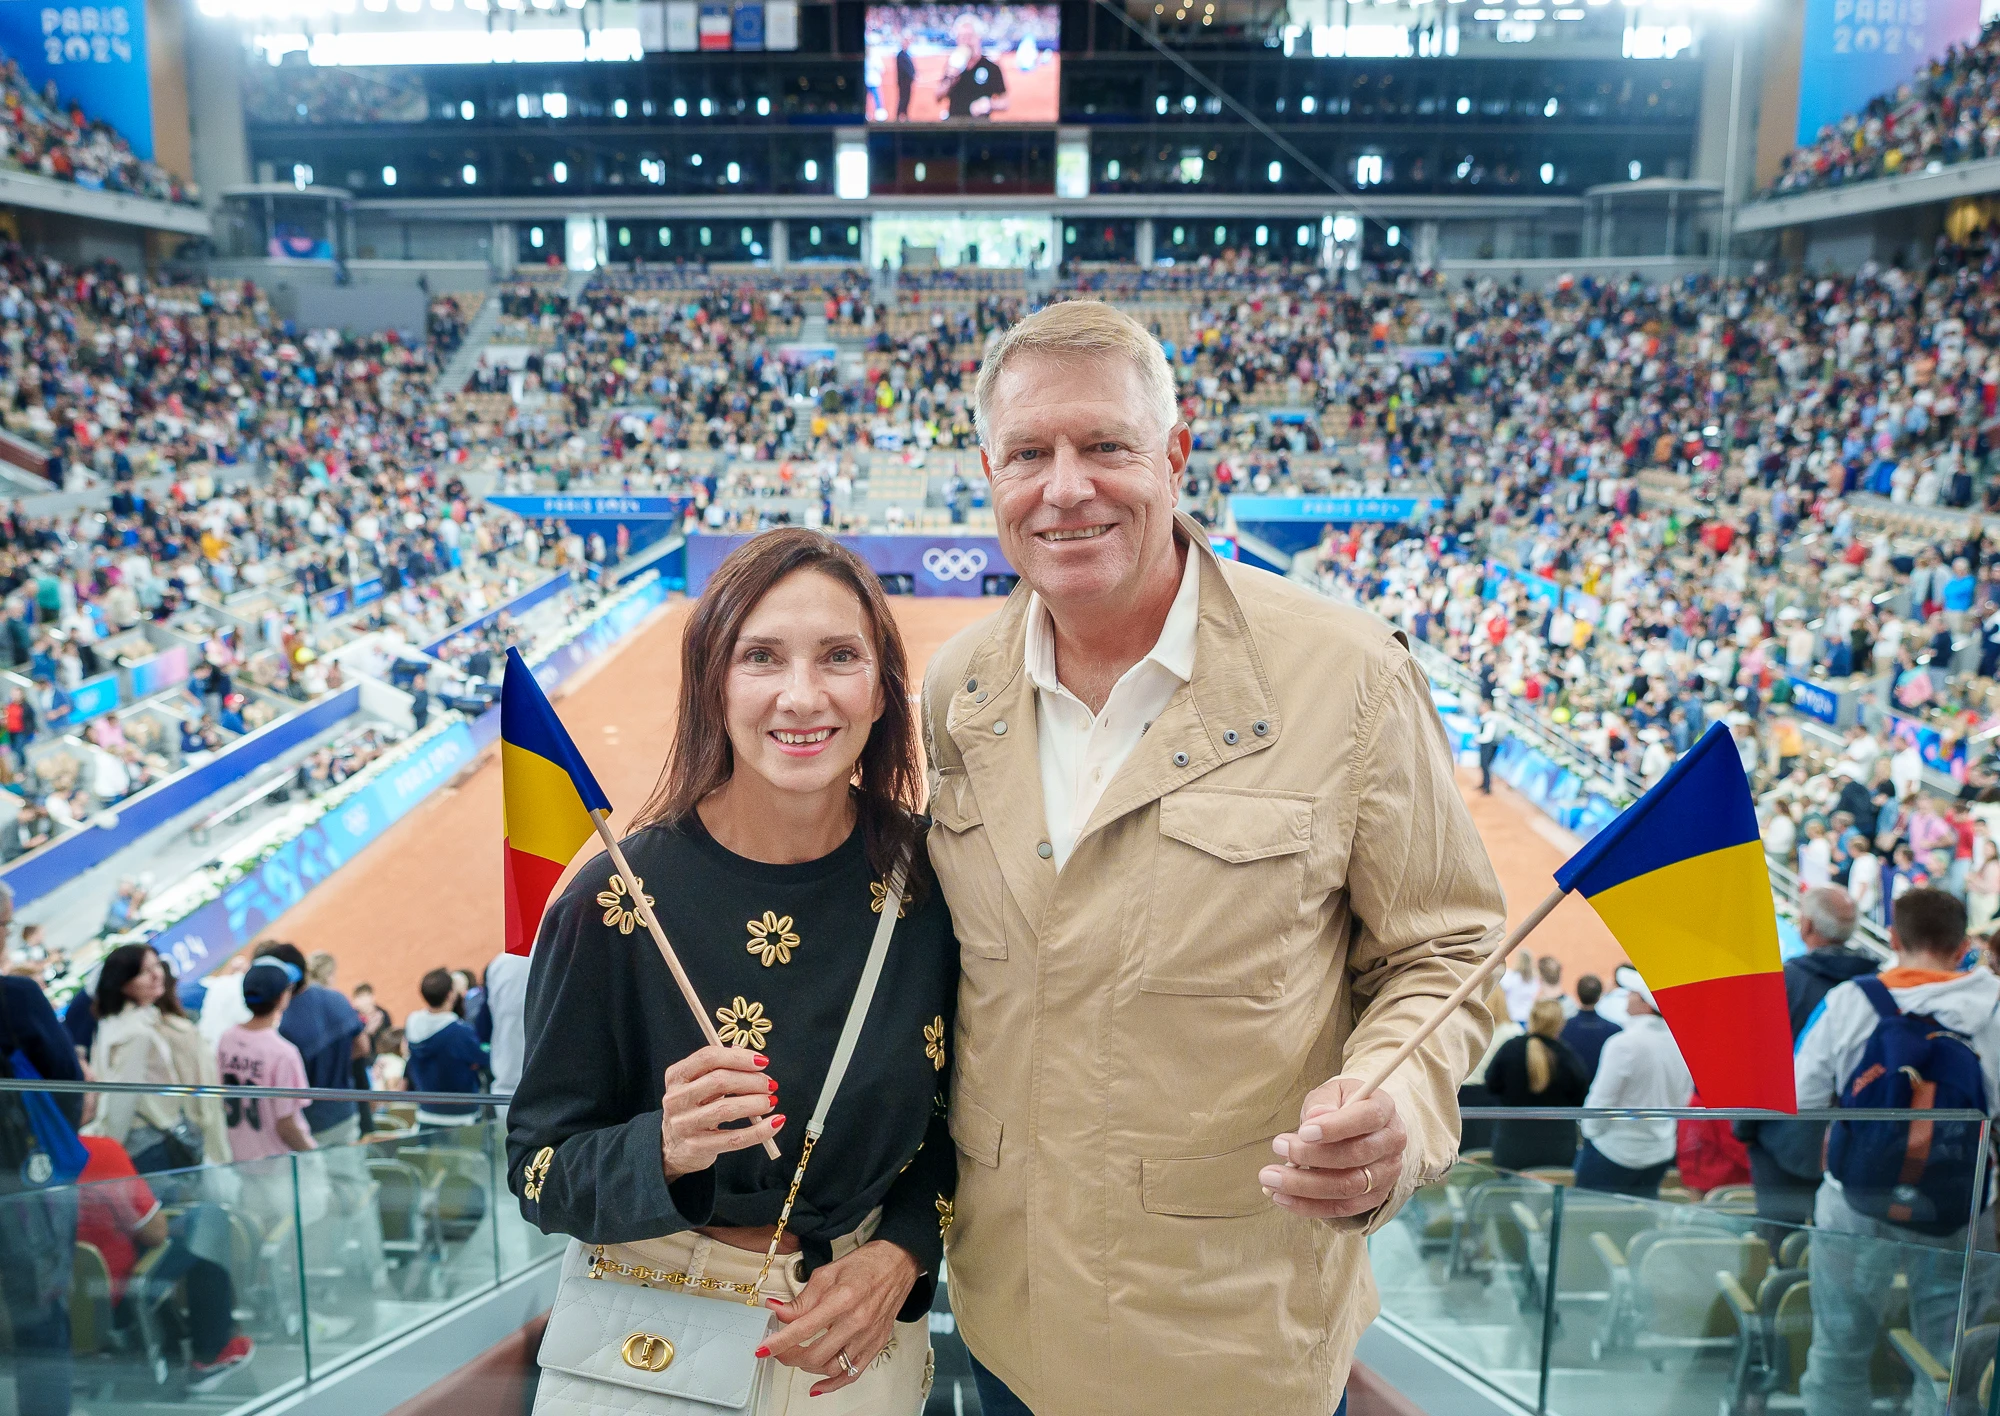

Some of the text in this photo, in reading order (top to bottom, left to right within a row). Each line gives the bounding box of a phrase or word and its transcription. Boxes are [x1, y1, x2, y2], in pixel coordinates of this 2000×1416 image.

[41, 6, 129, 36] PARIS
[1834, 0, 1926, 25] PARIS
[44, 36, 131, 64] 2024
[1833, 25, 1924, 54] 2024
[159, 933, 209, 980] 024
